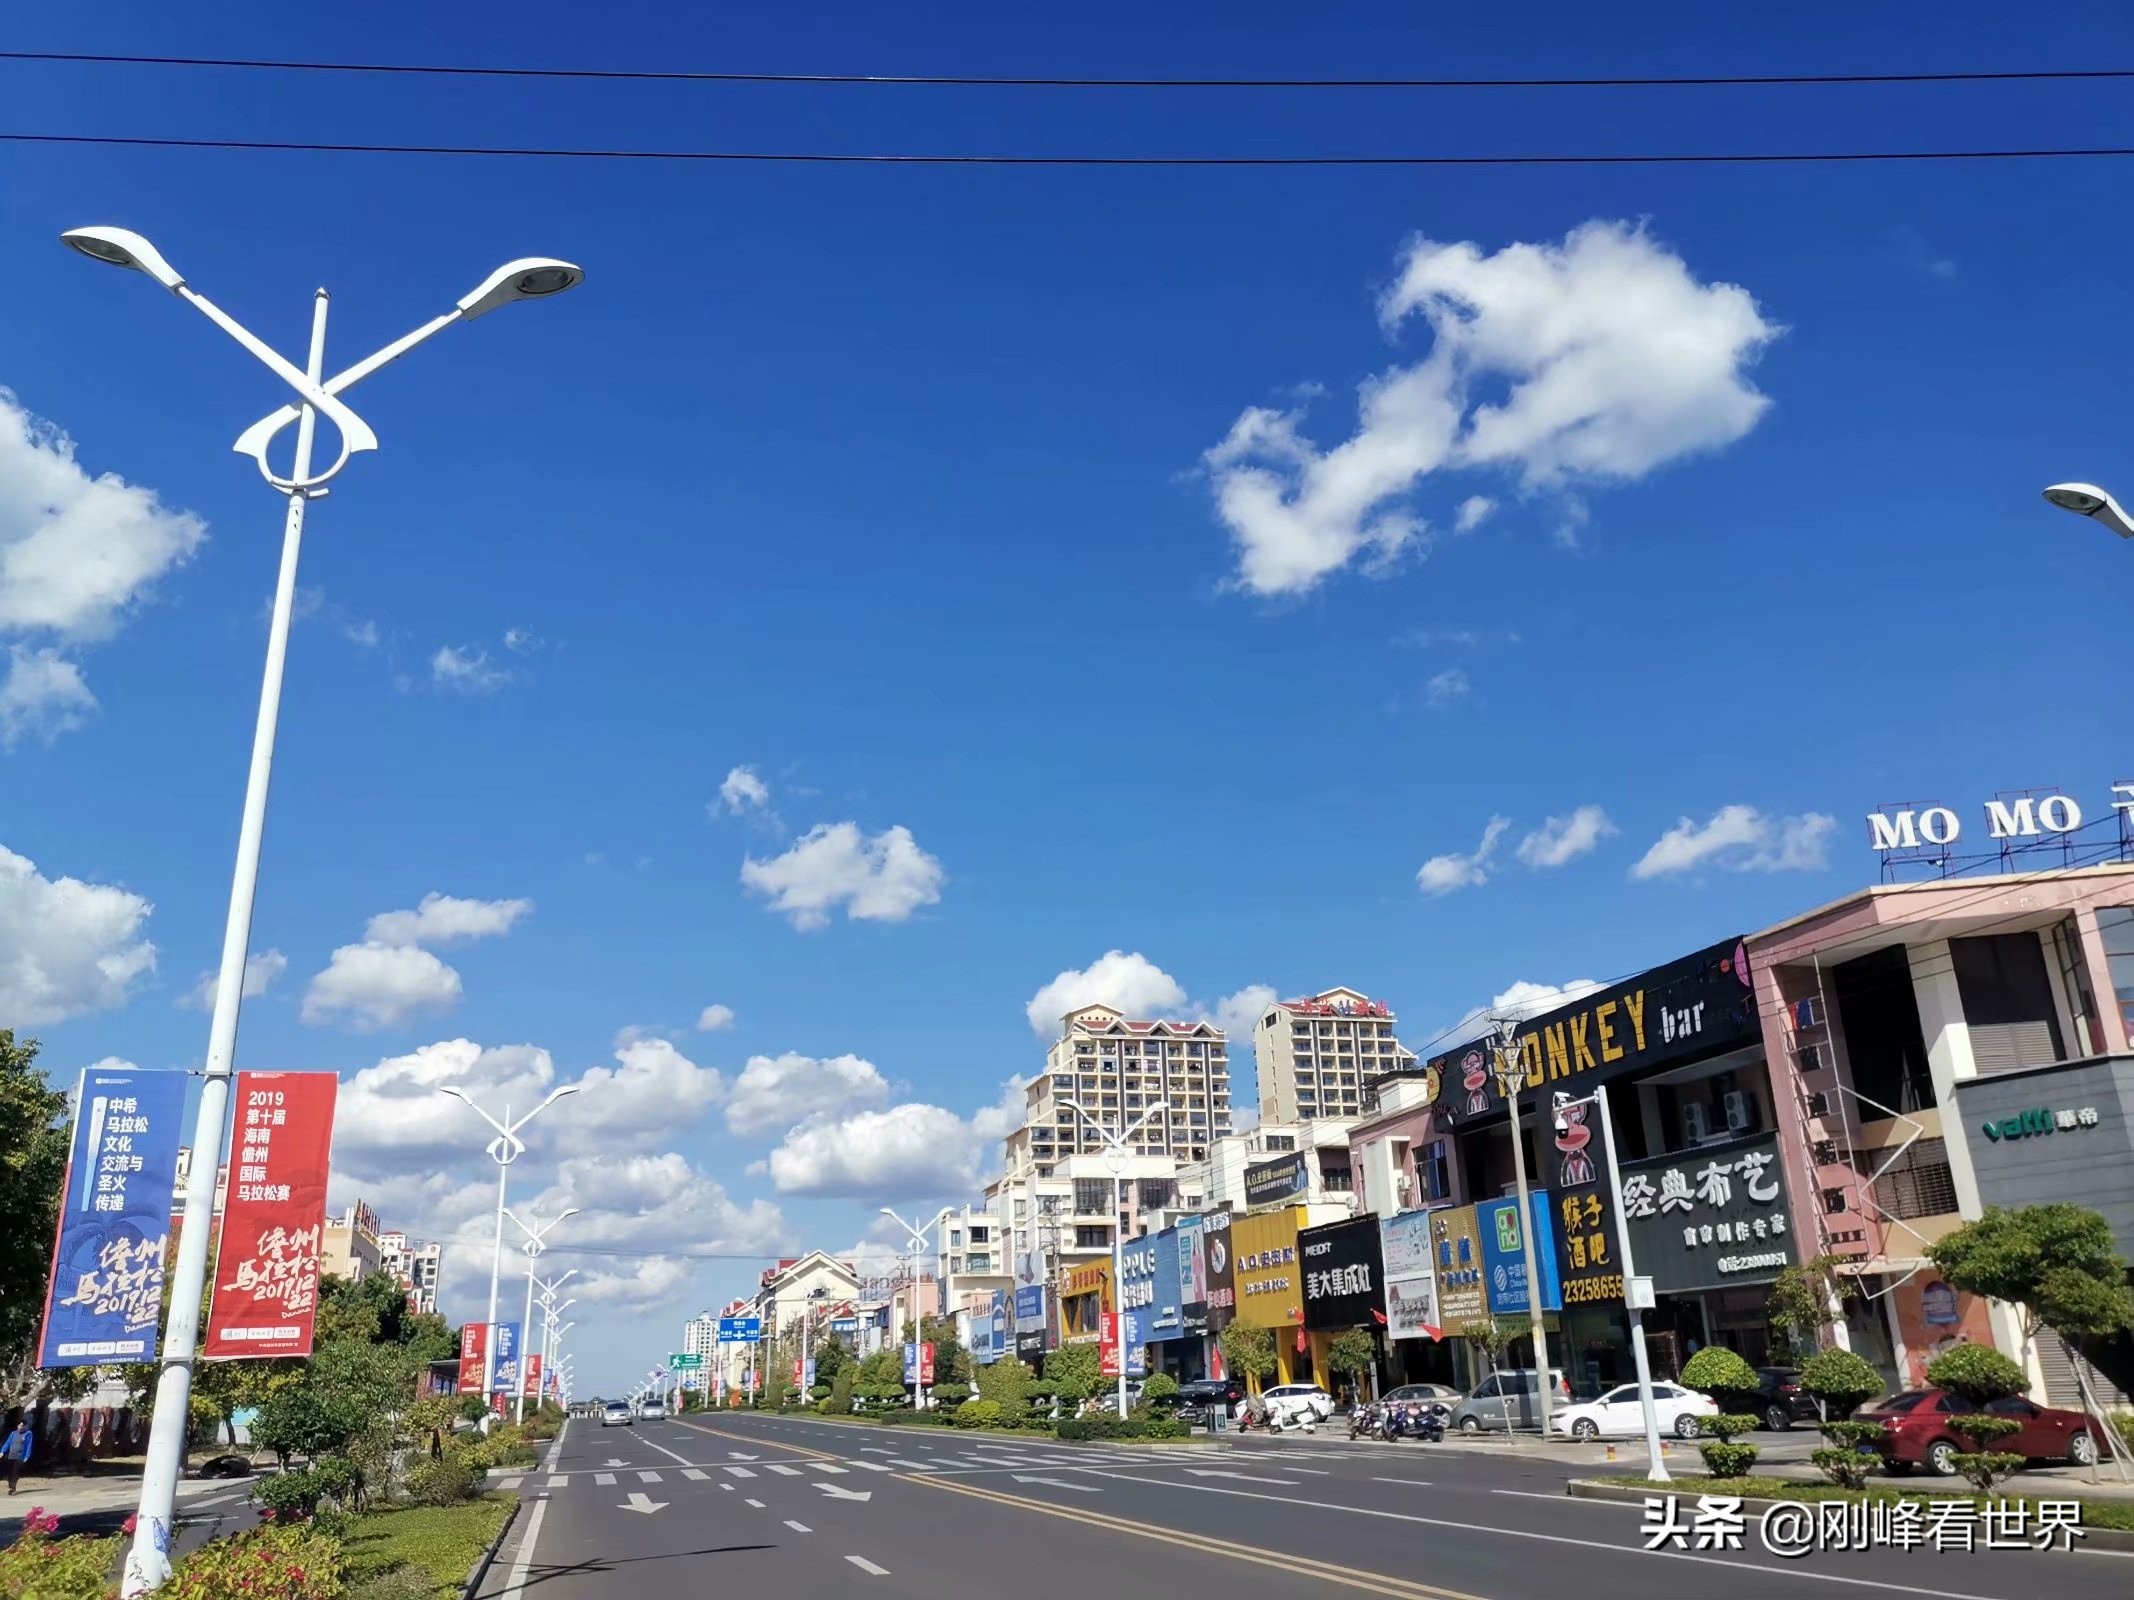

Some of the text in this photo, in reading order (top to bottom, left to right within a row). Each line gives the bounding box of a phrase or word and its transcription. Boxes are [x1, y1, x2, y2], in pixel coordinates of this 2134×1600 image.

[1866, 807, 1960, 850] MO
[1984, 795, 2082, 839] MO
[1660, 1001, 1704, 1044] bar
[109, 1097, 138, 1114] 中希
[248, 1091, 284, 1106] 2019
[106, 1116, 149, 1133] 马拉松
[246, 1108, 286, 1125] 第十届
[103, 1135, 132, 1153] 文化
[243, 1127, 271, 1144] 海南
[242, 1146, 269, 1163] 儋州
[100, 1155, 143, 1172] 交流与
[239, 1165, 267, 1182] 国际
[97, 1174, 126, 1191] 圣火
[1622, 1152, 1779, 1219] 经典布艺
[237, 1184, 290, 1201] 马拉松赛
[95, 1194, 124, 1212] 传递
[1562, 1194, 1604, 1234] 猴子
[1567, 1232, 1610, 1270] 酒吧
[1306, 1263, 1373, 1300] 美大集成灶
[1563, 1275, 1625, 1303] 23258655
